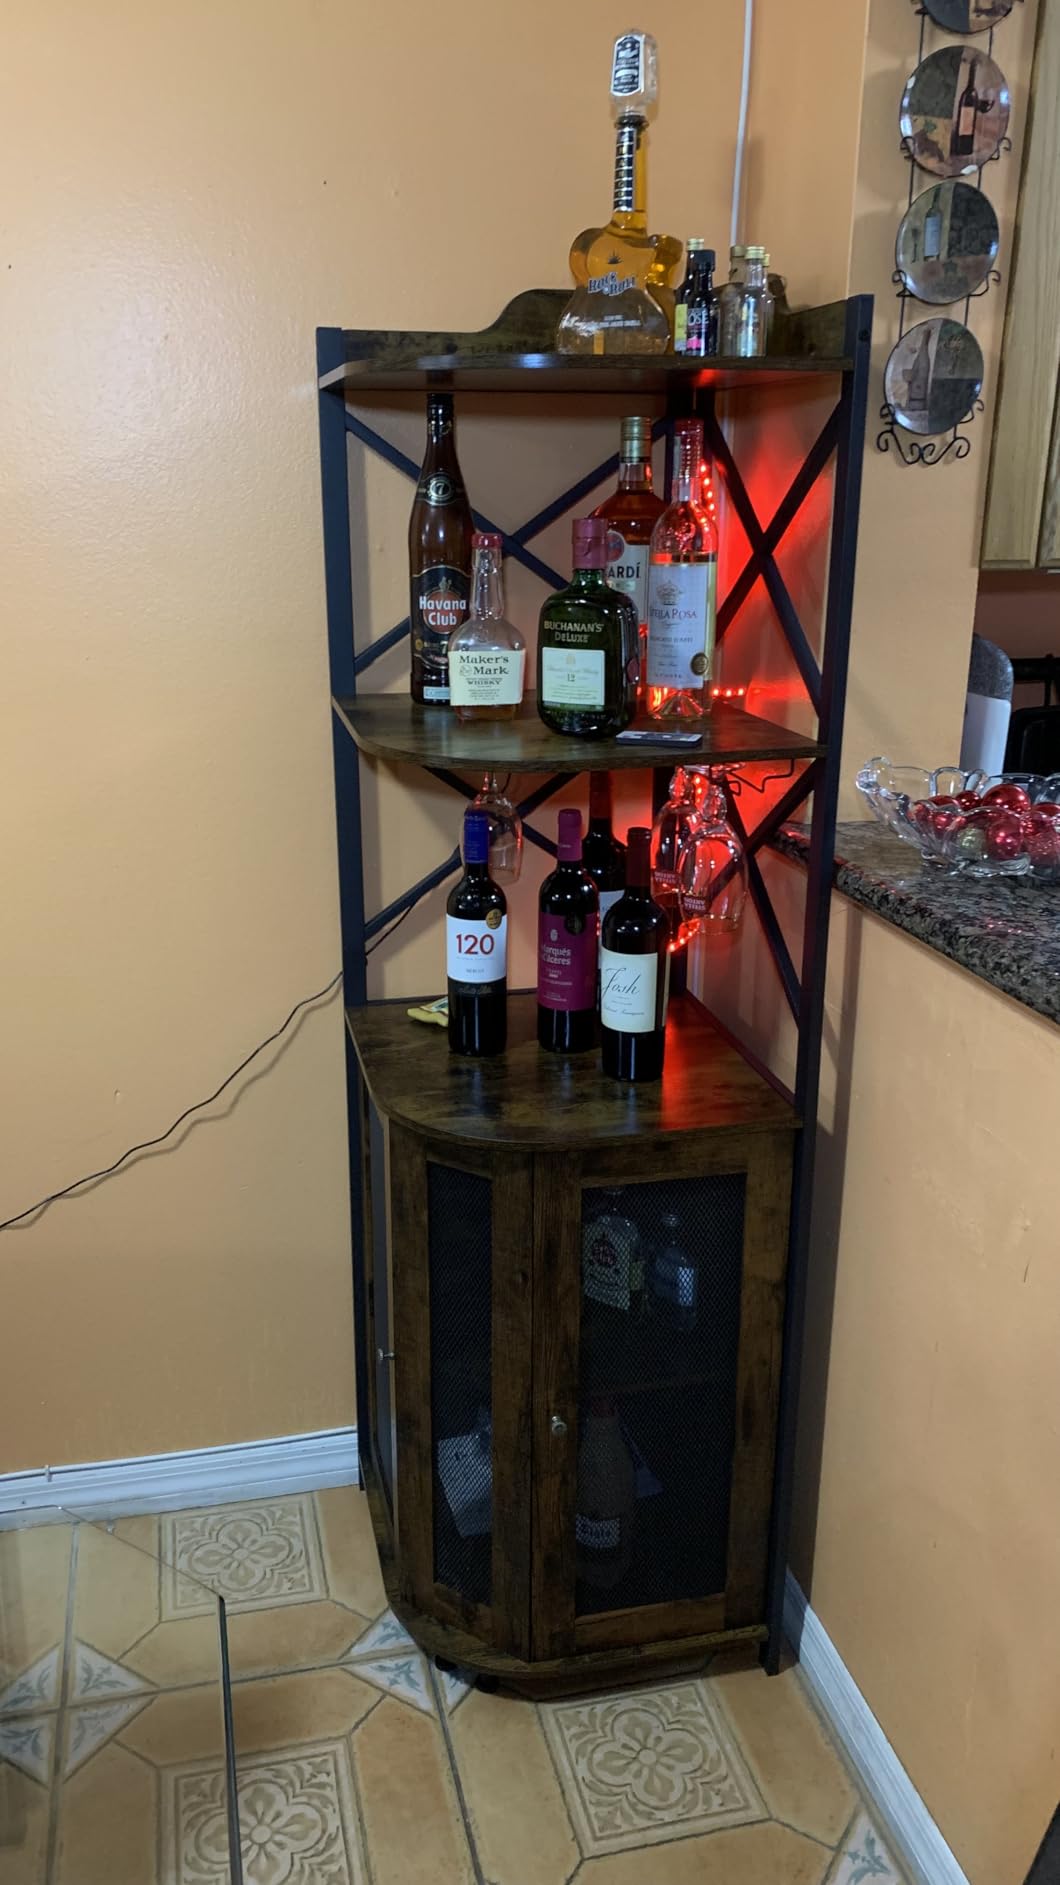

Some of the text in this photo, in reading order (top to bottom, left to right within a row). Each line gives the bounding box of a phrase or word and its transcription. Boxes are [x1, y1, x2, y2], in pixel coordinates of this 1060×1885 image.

[436, 482, 445, 495] 7
[608, 562, 641, 579] ARDÍ
[419, 596, 467, 610] Havana
[428, 612, 457, 626] Club
[544, 620, 605, 633] BUCHANAN'S
[459, 655, 509, 664] Maker's
[473, 666, 510, 675] Mark
[456, 934, 495, 955] 120
[602, 967, 641, 999] Josh
